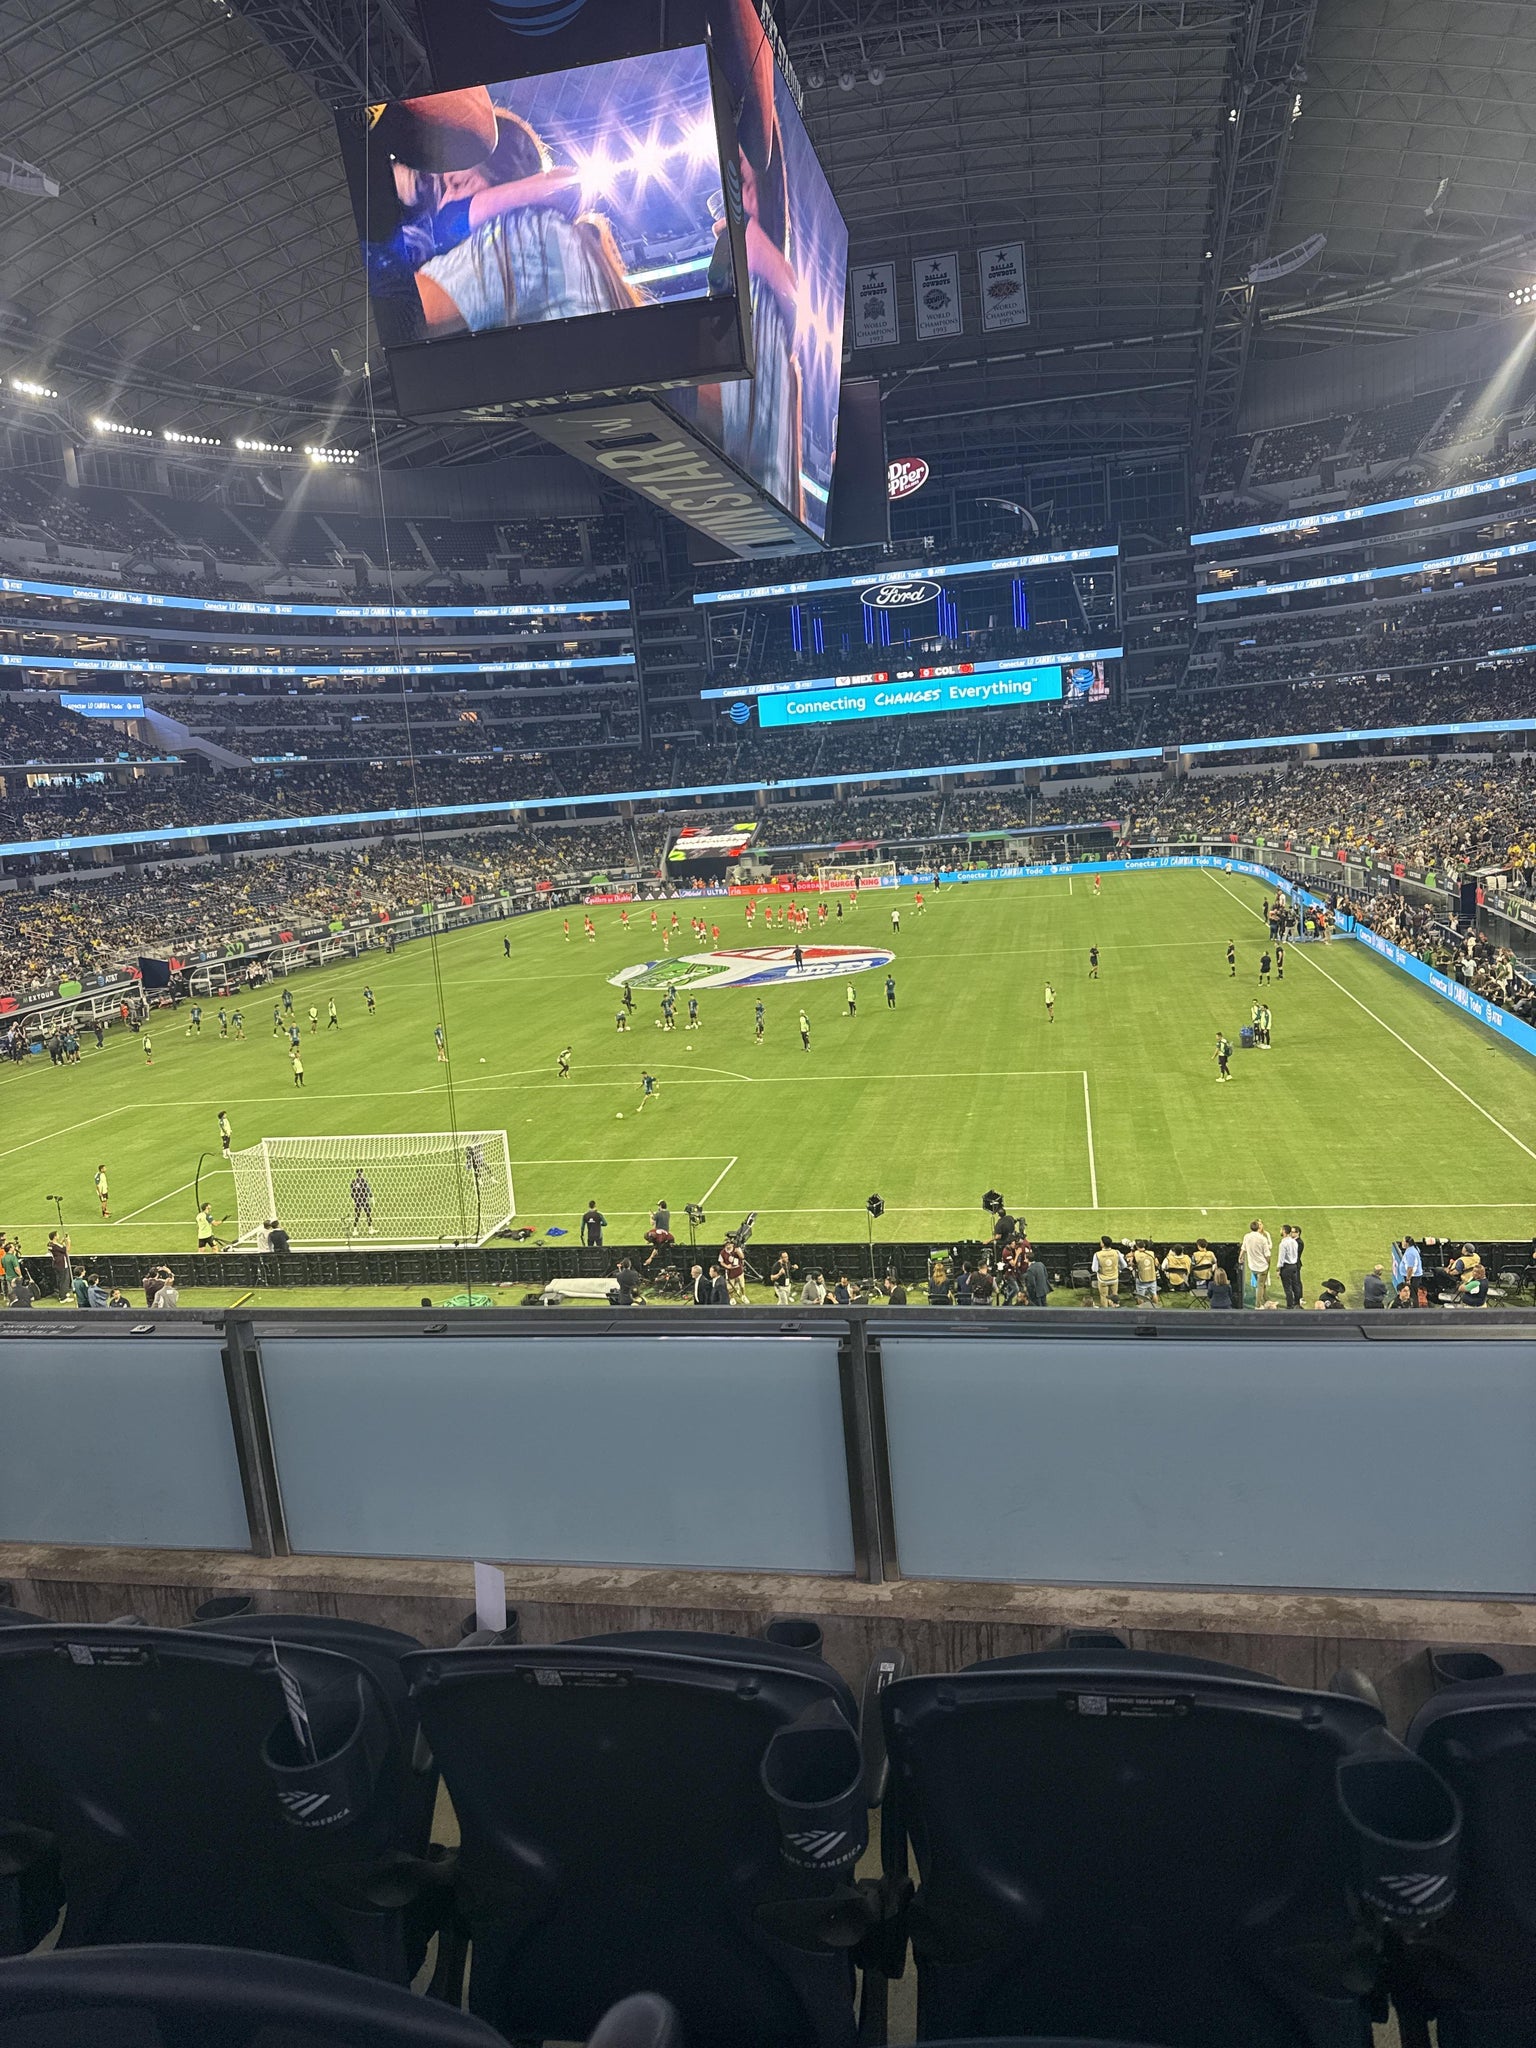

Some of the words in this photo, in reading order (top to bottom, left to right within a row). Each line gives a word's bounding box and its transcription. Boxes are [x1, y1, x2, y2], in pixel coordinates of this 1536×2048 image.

[990, 262, 1014, 272] DALLAS
[924, 272, 948, 281] DALLAS
[988, 269, 1016, 278] COWBOYS
[862, 282, 884, 290] DALLAS
[922, 278, 950, 288] COWBOYS
[860, 288, 887, 297] COWBOYS
[926, 312, 950, 320] WORLD
[986, 309, 1025, 320] CHAMPIONS
[920, 319, 958, 329] CHAMPIONS
[857, 328, 894, 337] CHAMPIONS
[461, 380, 692, 416] WINSTAR
[889, 462, 910, 480] Dr
[888, 466, 924, 496] pper
[596, 441, 797, 546] WINSTAR
[1414, 495, 1443, 504] Conectar
[1444, 490, 1451, 499] LO
[1452, 484, 1474, 497] CAMBIA
[1506, 476, 1518, 484] AT&T
[1260, 524, 1288, 533] Conectar
[992, 560, 1018, 568] Conectar
[1423, 560, 1451, 569] Conectar
[73, 589, 99, 599] Conectar
[128, 594, 142, 602] Todo
[876, 584, 926, 604] Ford
[935, 666, 956, 676] COL
[852, 674, 873, 684] MEX
[787, 696, 866, 715] Connecting
[874, 689, 942, 707] CHANGES
[1125, 860, 1157, 868] Conectar
[1171, 856, 1194, 865] CAMBIA
[957, 872, 988, 880] Conectar
[1000, 867, 1023, 877] CAMBIA
[830, 880, 857, 889] BURGE
[106, 974, 118, 983] AT&T
[22, 990, 54, 1003] MEXTOUR
[1430, 972, 1447, 993] Conectar
[1454, 984, 1468, 1011] CAMBIA
[1470, 997, 1482, 1015] Todo
[1492, 1011, 1503, 1026] AT&T
[306, 1808, 350, 1828] AMERICA
[820, 1843, 862, 1869] AMERICA
